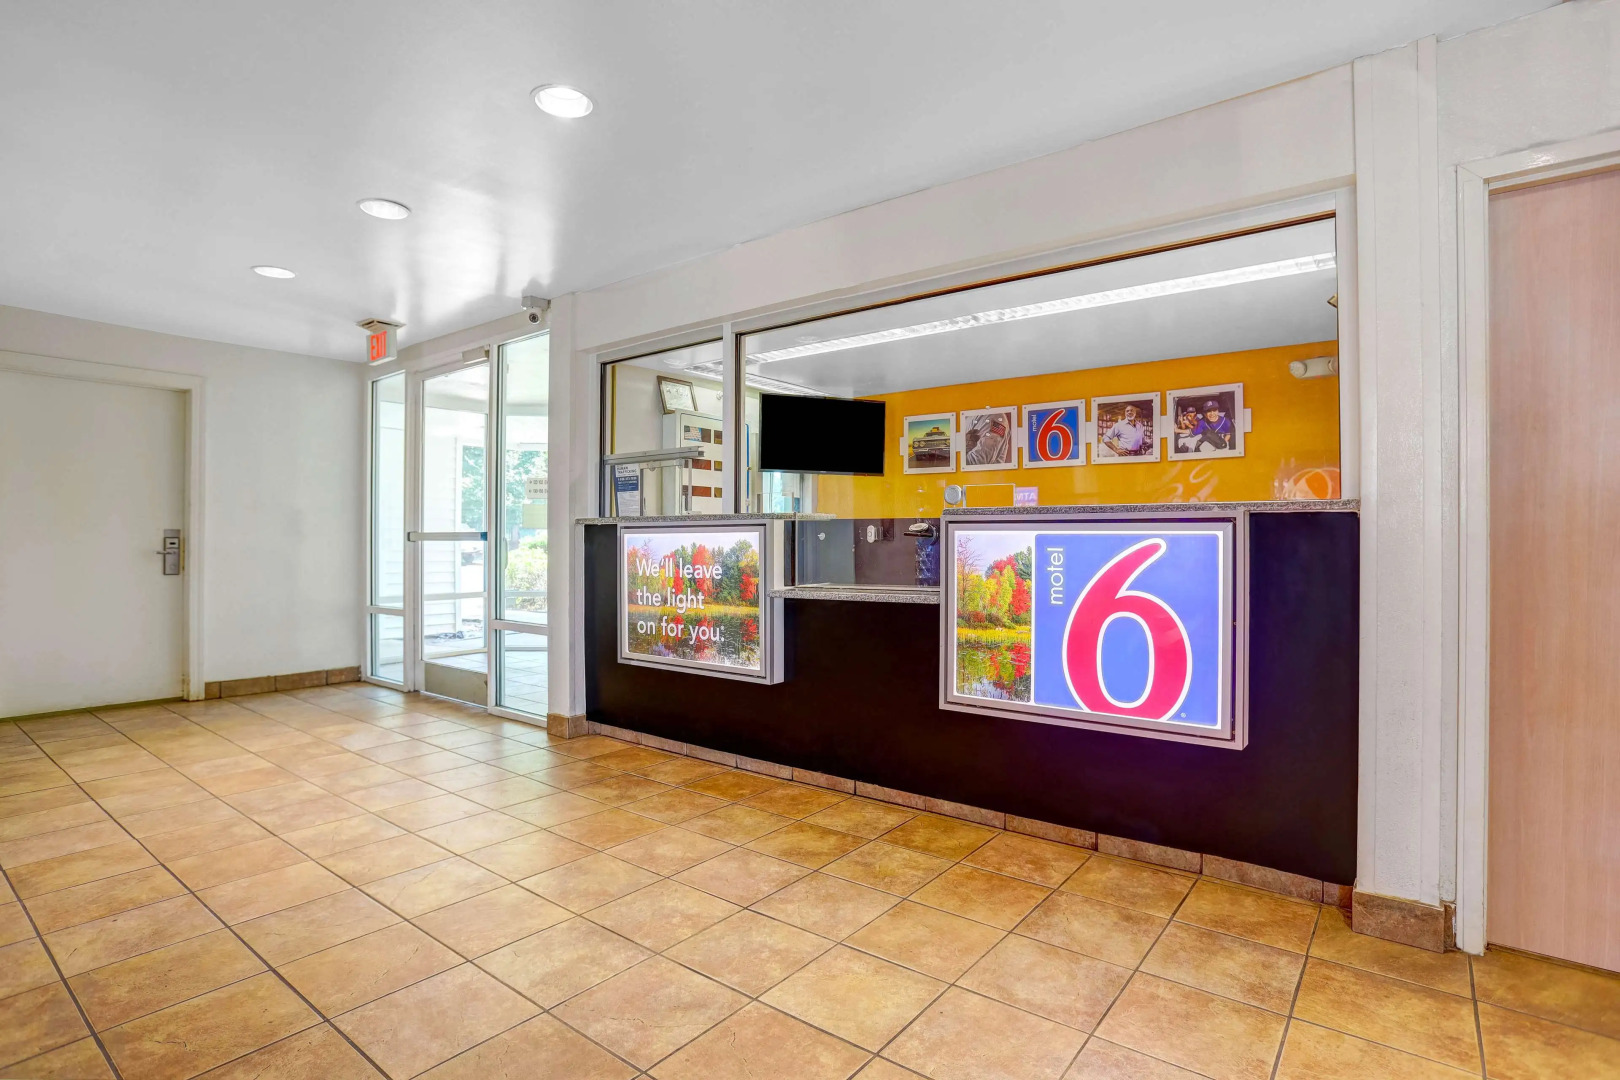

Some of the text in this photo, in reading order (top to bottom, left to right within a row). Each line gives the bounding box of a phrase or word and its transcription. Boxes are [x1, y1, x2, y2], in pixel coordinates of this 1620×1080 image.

[370, 331, 388, 361] EXIT
[1037, 408, 1073, 461] 6
[636, 558, 722, 579] We'll leave
[636, 586, 705, 614] the light
[637, 620, 656, 635] on
[661, 616, 684, 638] for
[1047, 537, 1193, 722] motel 6
